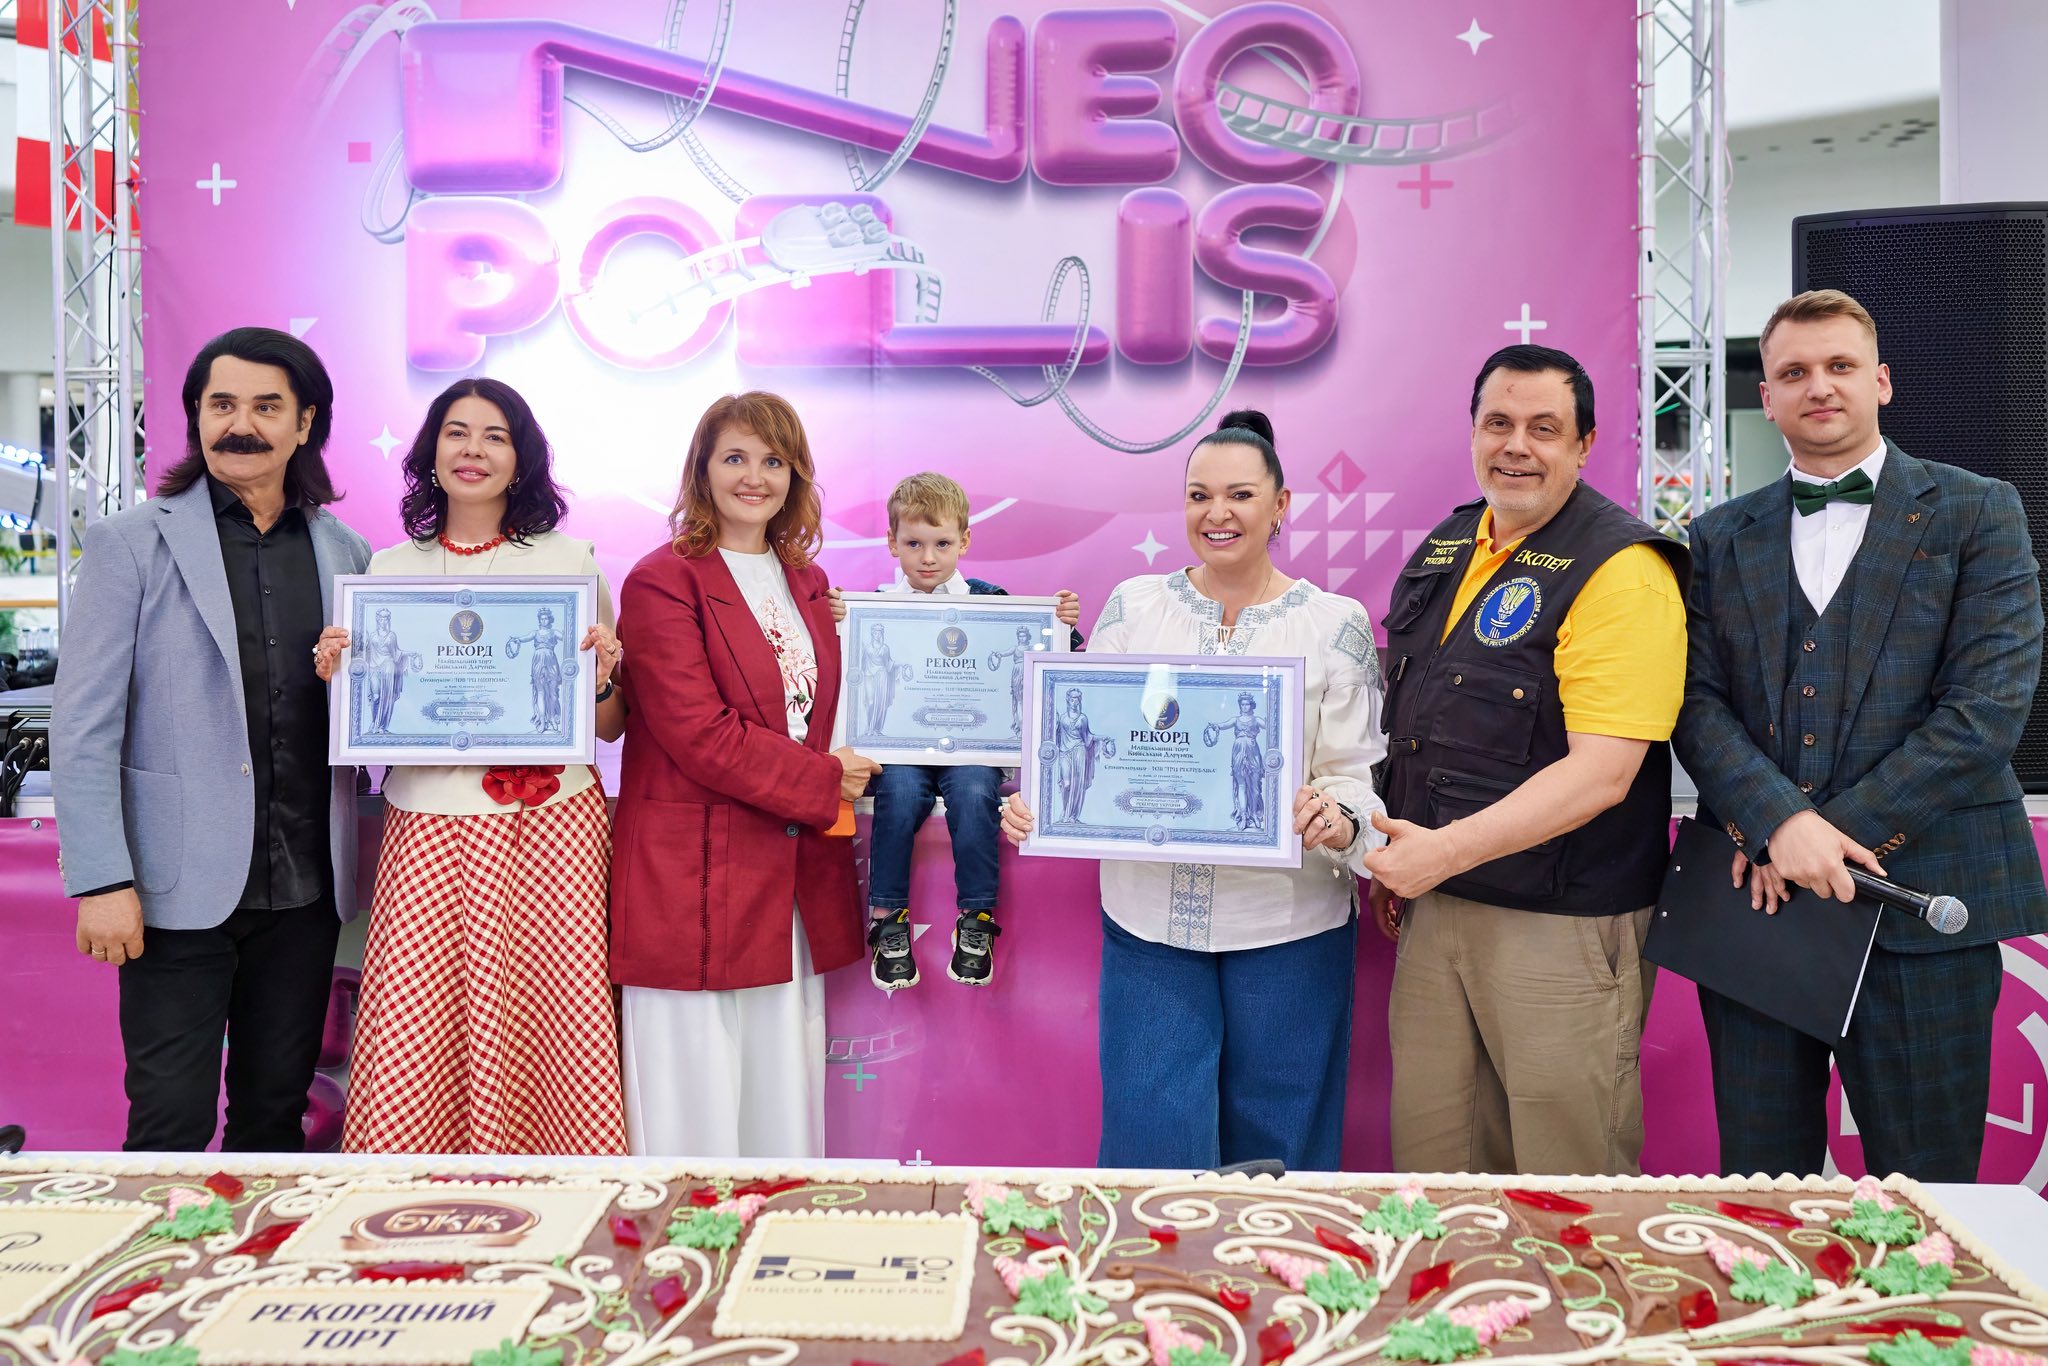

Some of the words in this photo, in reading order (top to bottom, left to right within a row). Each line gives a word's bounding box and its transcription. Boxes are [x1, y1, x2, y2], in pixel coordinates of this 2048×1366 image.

[405, 184, 1339, 371] POLIS
[1514, 549, 1576, 573] ЕКСПЕРТ
[437, 645, 493, 657] РЕКОРД
[926, 658, 977, 669] РЕКОРД
[1130, 730, 1190, 745] РЕКОРД
[250, 1299, 497, 1324] РЕКОРДНИЙ
[302, 1328, 406, 1349] ТОРТ
